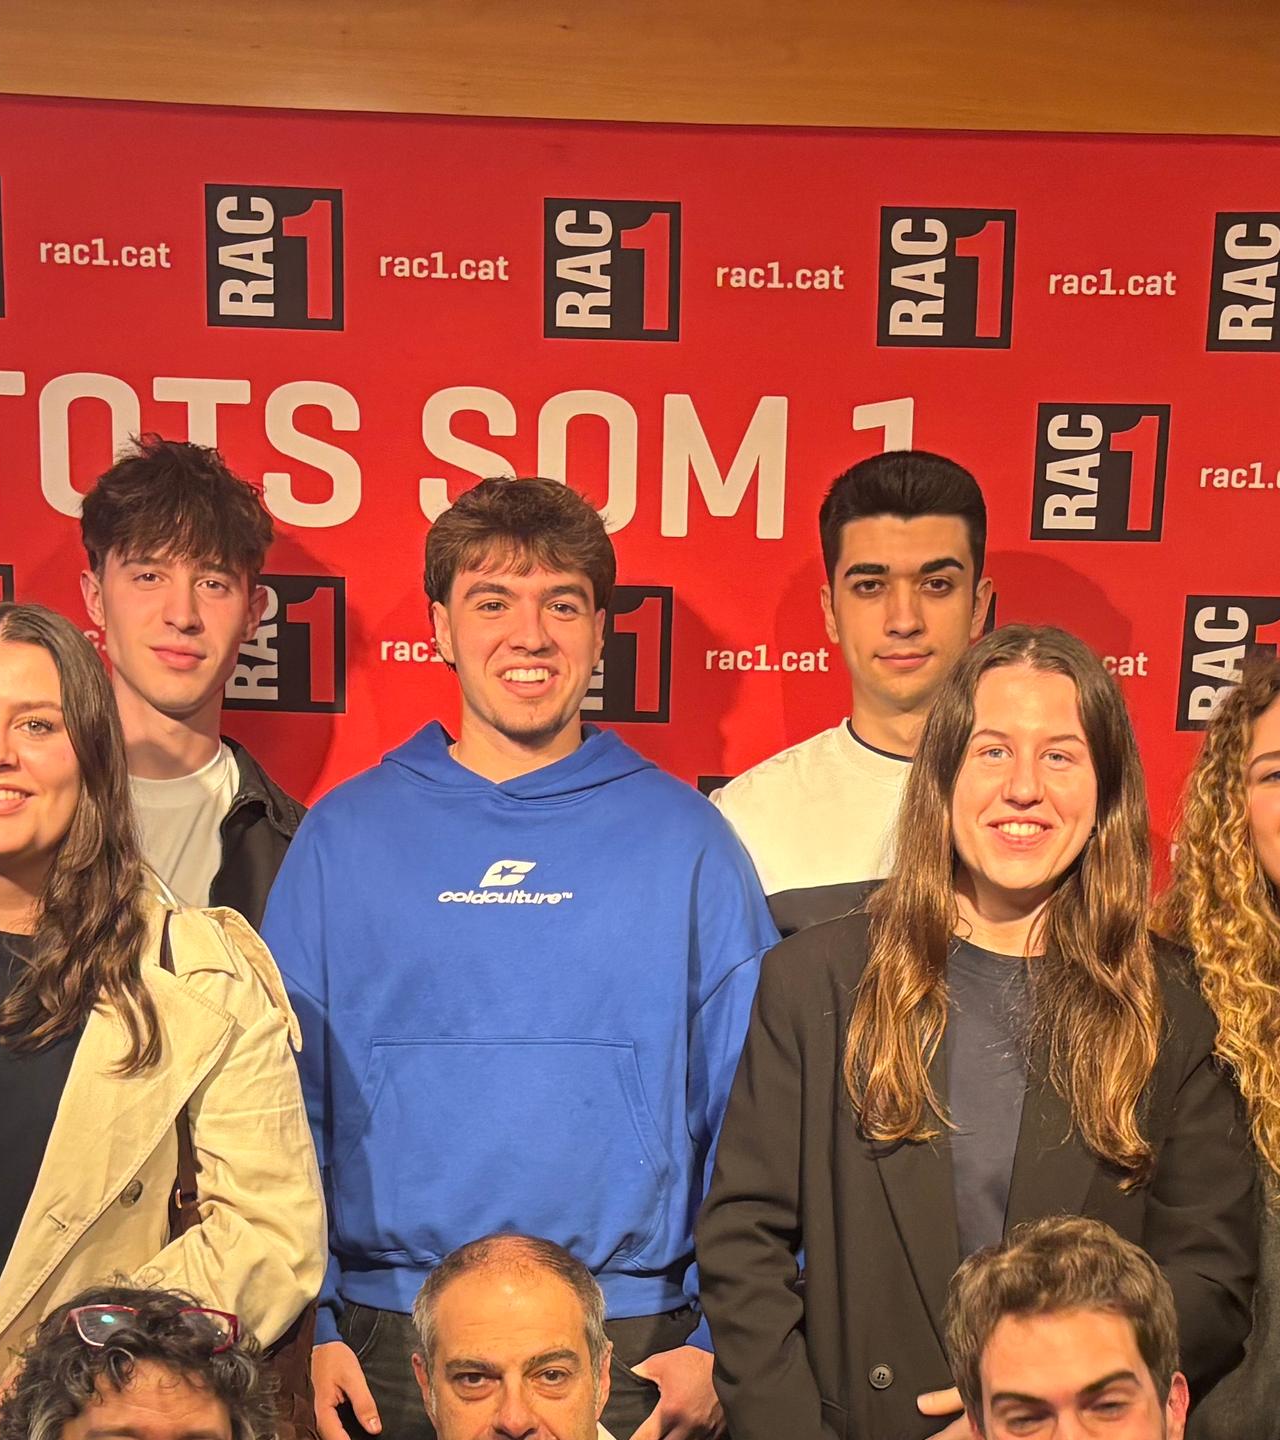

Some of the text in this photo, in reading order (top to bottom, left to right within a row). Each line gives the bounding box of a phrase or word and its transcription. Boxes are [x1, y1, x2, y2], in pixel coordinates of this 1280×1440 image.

[39, 236, 172, 269] rac1.cat
[216, 194, 334, 321] RAC 1
[378, 250, 510, 283] rac1.cat
[554, 208, 672, 332] RAC 1
[716, 261, 846, 292] rac1.cat
[888, 216, 1006, 339] RAC 1
[1047, 267, 1177, 298] rac1.cat
[419, 384, 789, 541] SOM
[1041, 412, 1161, 532] RAC 1
[286, 586, 336, 703] 1
[704, 643, 831, 678] rac1.cat
